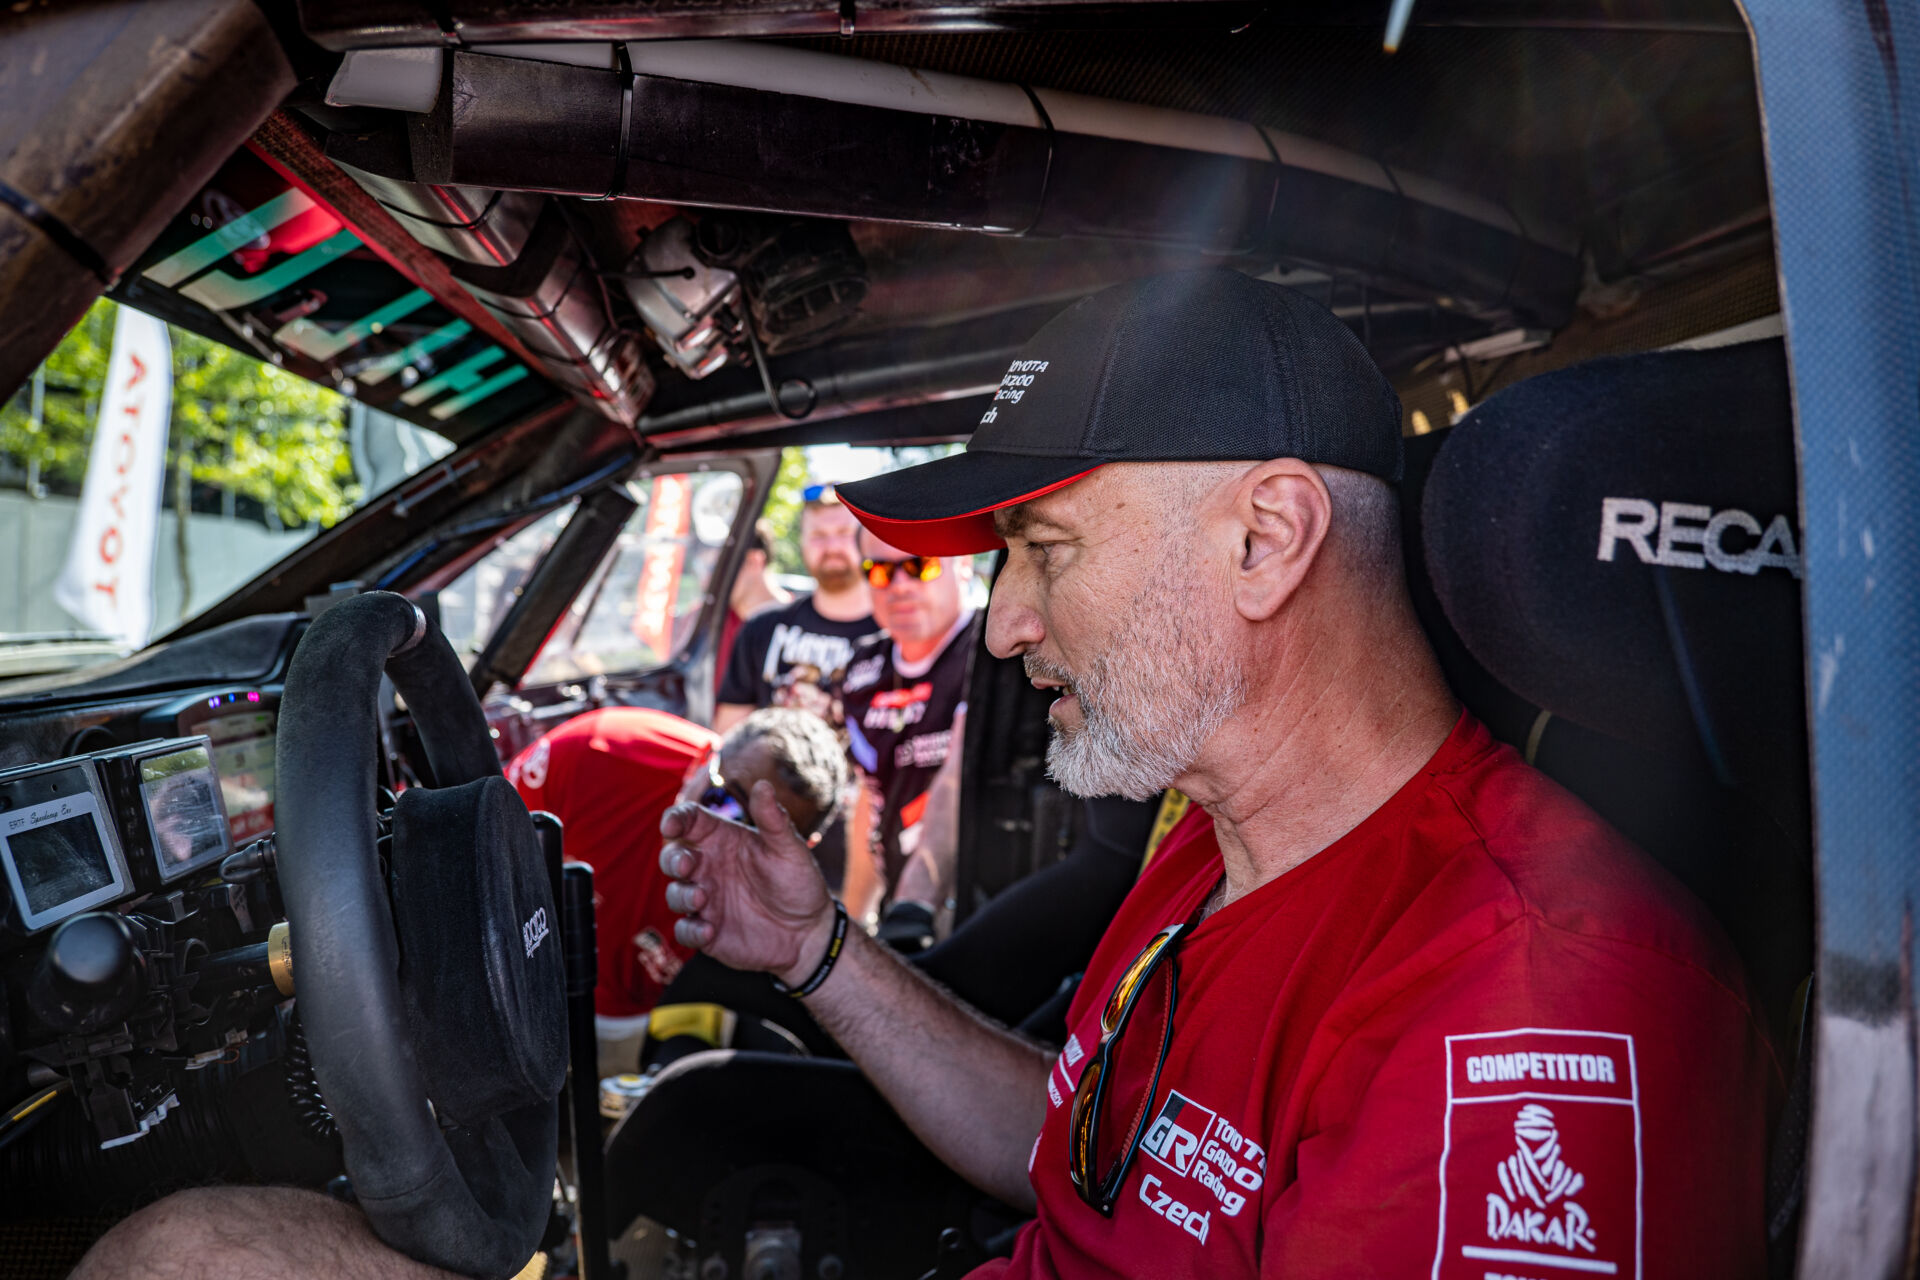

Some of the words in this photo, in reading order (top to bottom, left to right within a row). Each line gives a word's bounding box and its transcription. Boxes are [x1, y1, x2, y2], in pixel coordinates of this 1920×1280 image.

[1466, 1052, 1616, 1083] COMPETITOR
[1144, 1116, 1198, 1171] GR
[1139, 1173, 1212, 1247] Czech
[1486, 1192, 1596, 1253] DAKAR
